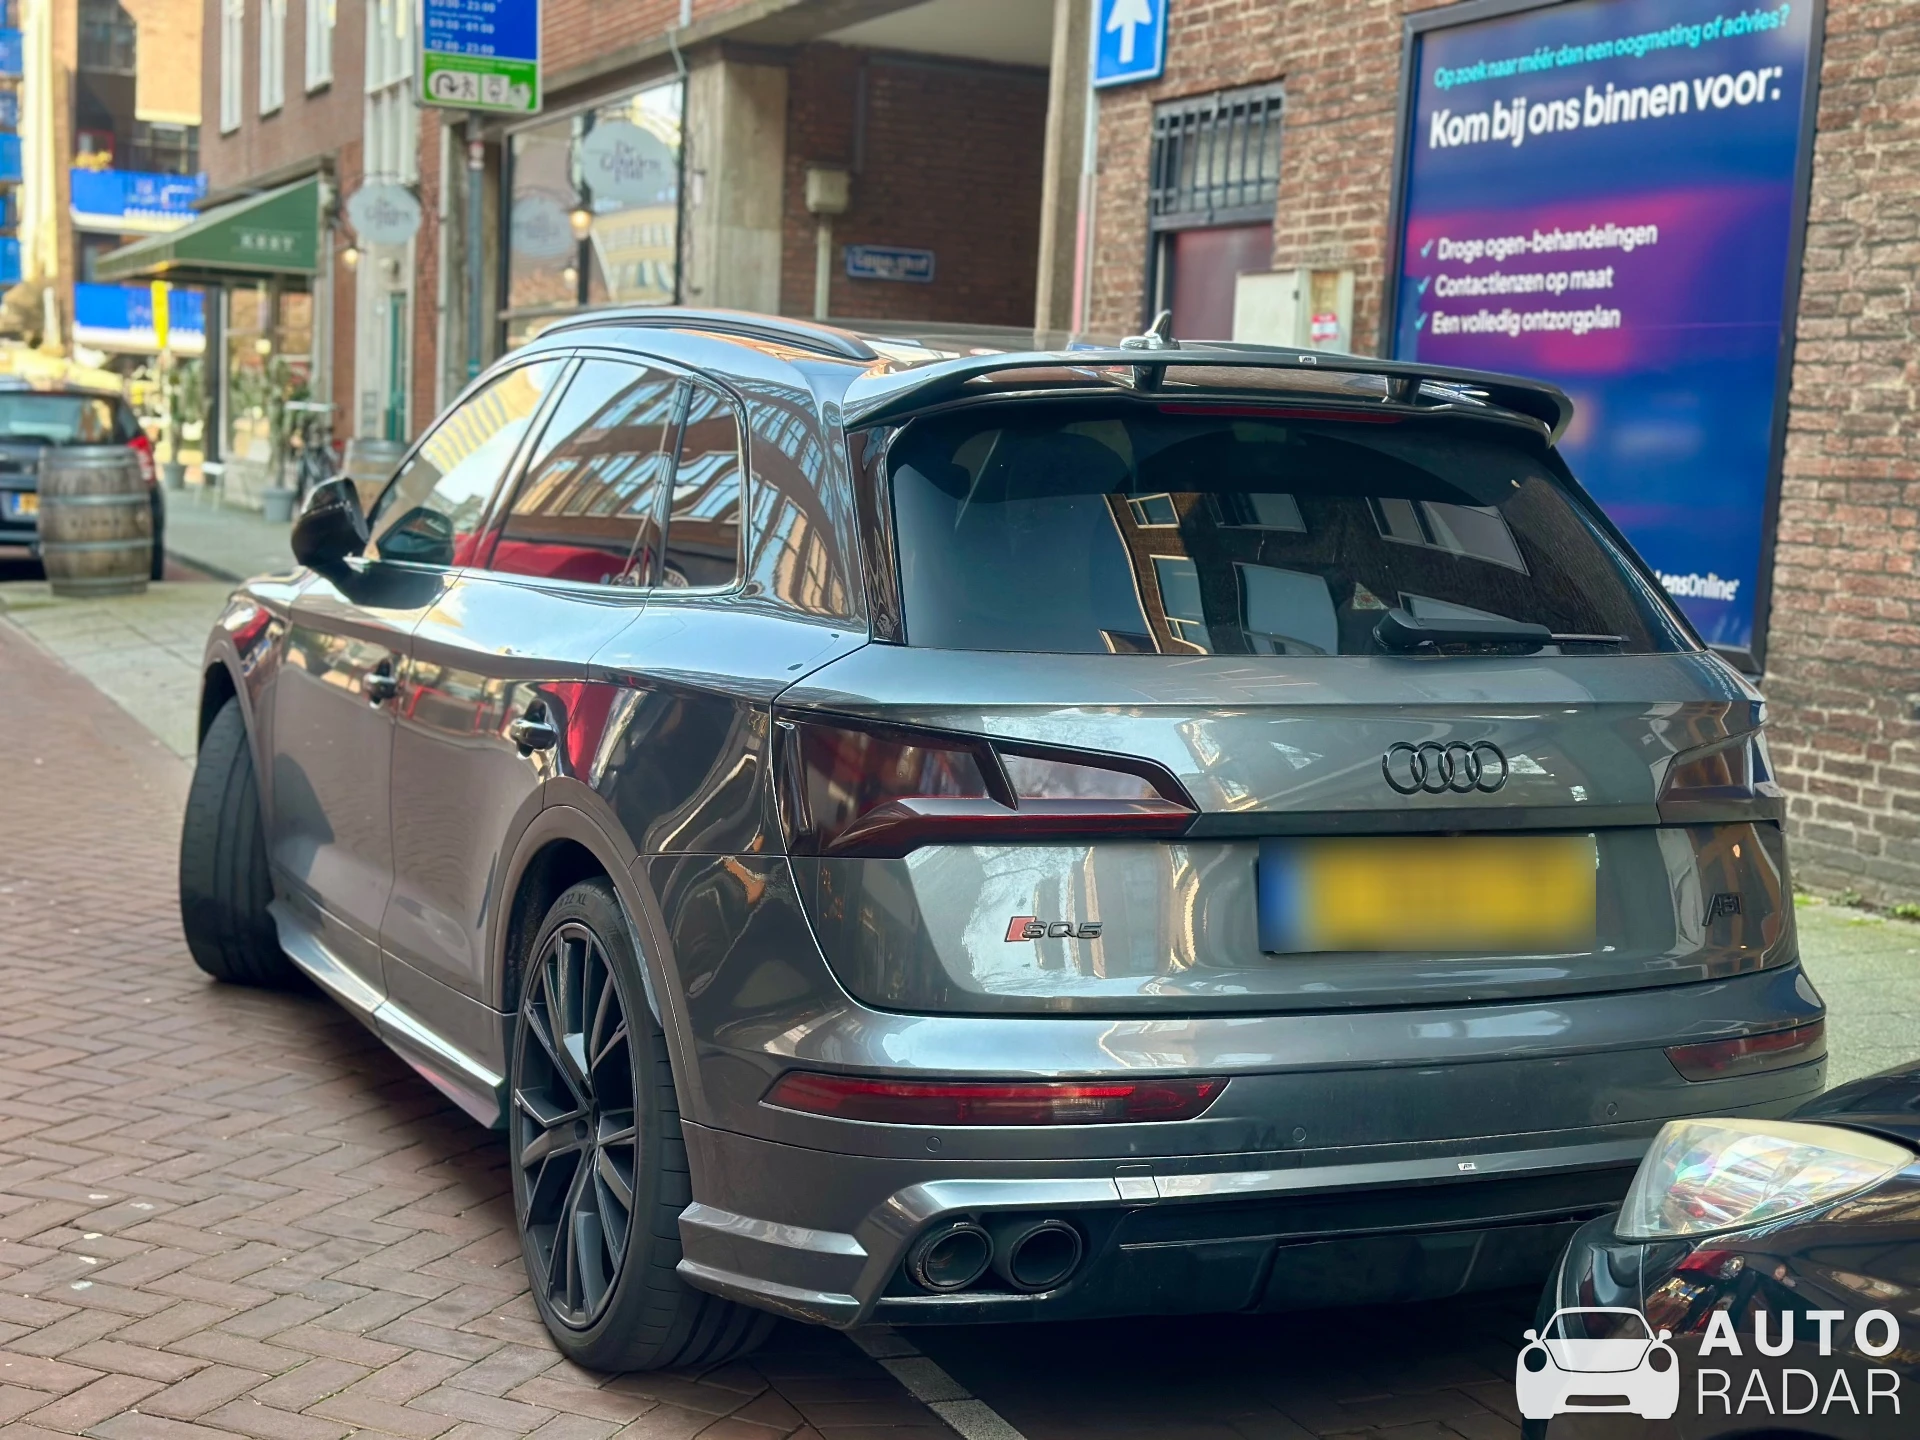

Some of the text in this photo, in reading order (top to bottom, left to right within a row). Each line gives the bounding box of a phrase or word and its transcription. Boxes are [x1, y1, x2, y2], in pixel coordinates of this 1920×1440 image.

[1434, 3, 1791, 91] Op zoek naar méér dan een oogmeting of advies?
[1429, 66, 1783, 149] Kom bij ons binnen voor:
[1437, 223, 1658, 264] Droge ogen-behandelingen
[1434, 265, 1614, 297] Contactlenzen op maat
[1431, 304, 1621, 337] Een volledig ontzorgplan
[1021, 920, 1103, 939] SQ5
